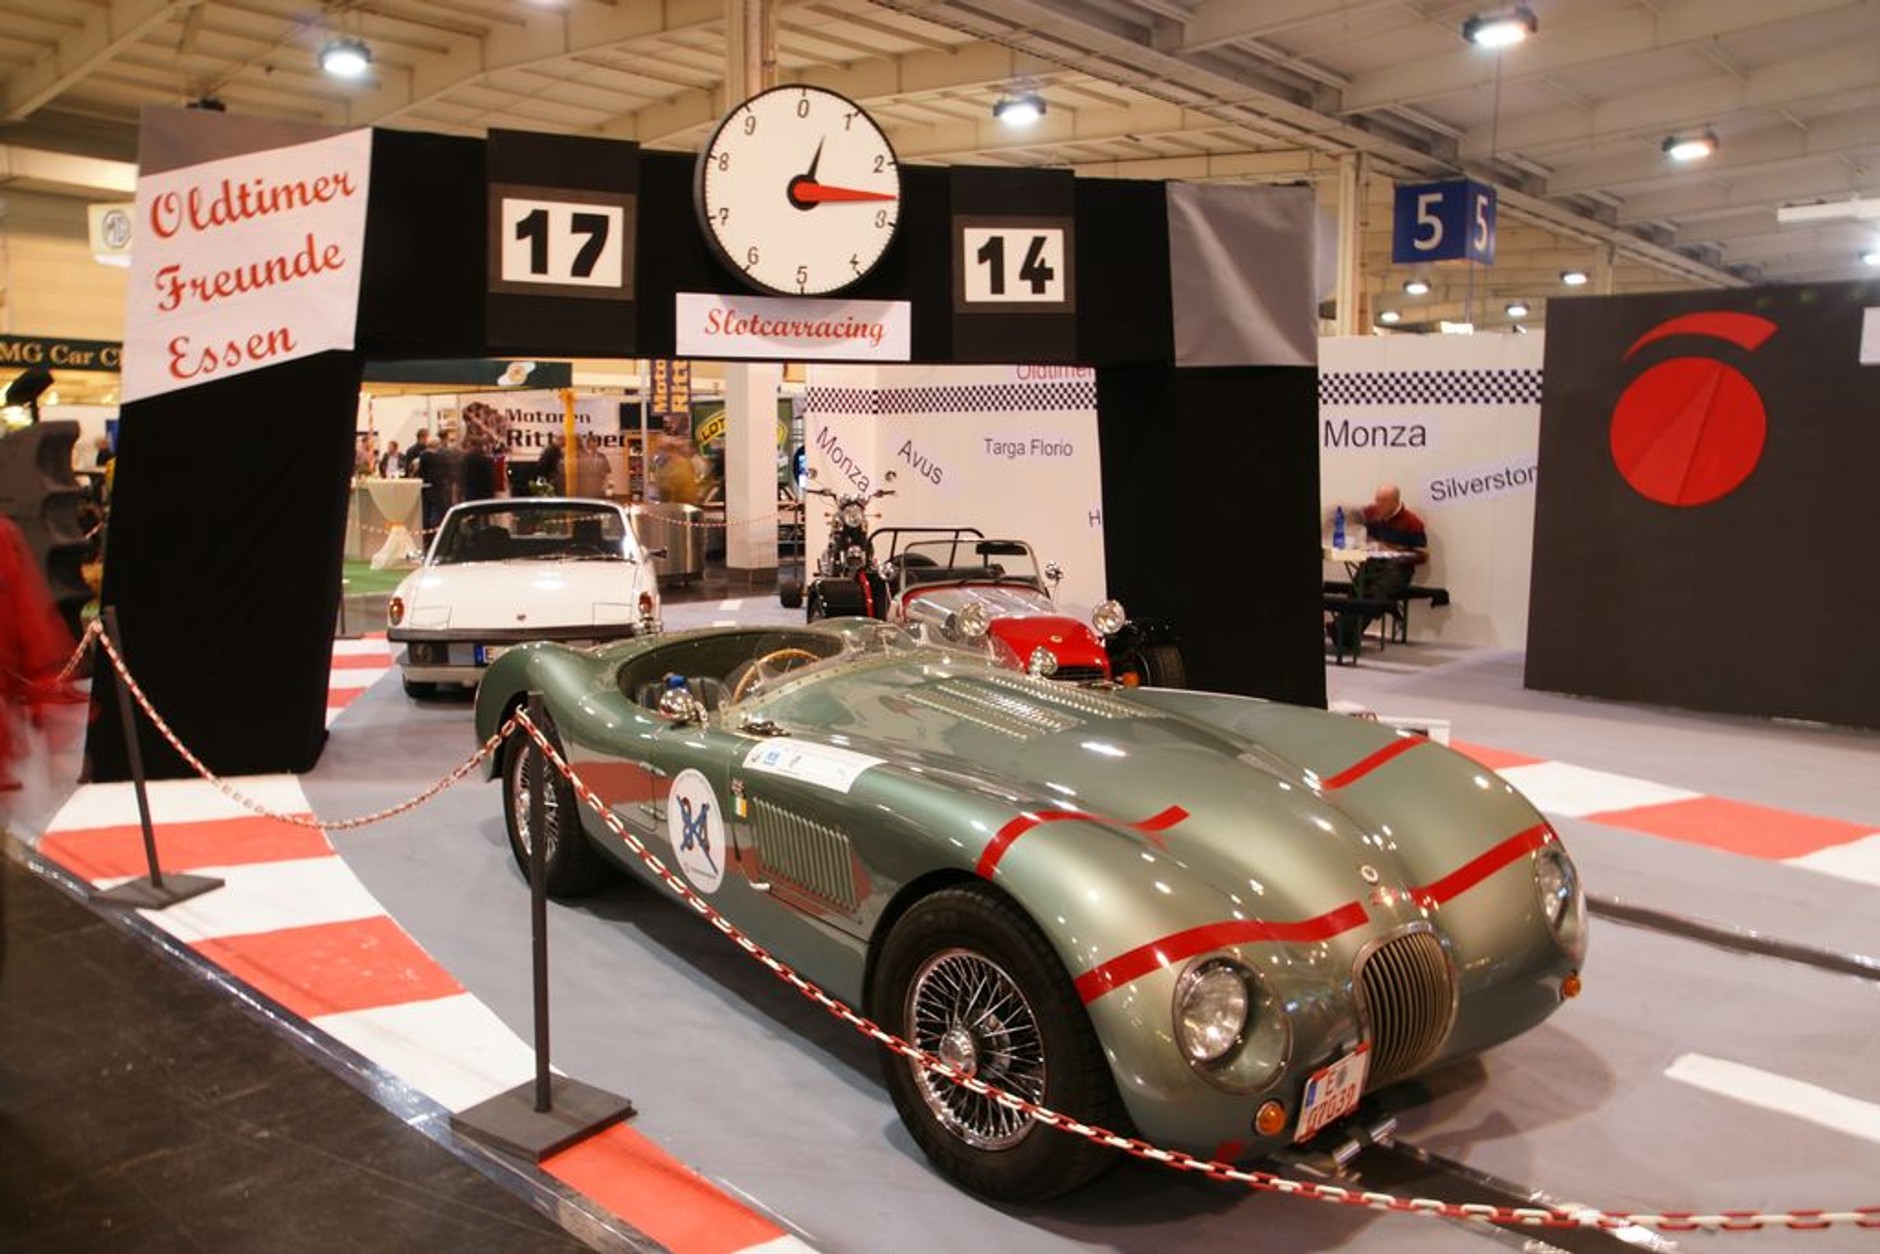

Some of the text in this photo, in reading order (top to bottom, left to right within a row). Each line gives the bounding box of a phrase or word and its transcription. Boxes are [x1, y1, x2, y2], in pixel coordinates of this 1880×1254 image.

[744, 115, 756, 136] 9
[843, 113, 853, 131] 1
[718, 152, 729, 171] 8
[873, 155, 885, 173] 2
[150, 171, 356, 239] Oldtimer
[874, 210, 886, 229] 3
[1414, 193, 1443, 251] 5
[1474, 194, 1489, 252] 5
[515, 209, 610, 278] 17
[748, 246, 759, 265] 6
[154, 232, 346, 312] Freunde
[796, 266, 808, 285] 5
[849, 253, 859, 272] 4
[977, 236, 1054, 295] 14
[705, 308, 884, 348] Slotcarracing
[0, 343, 43, 364] MG
[50, 344, 95, 365] Car
[168, 326, 296, 379] Essen
[1323, 418, 1427, 448] Monza
[816, 426, 870, 493] Monza
[898, 440, 944, 485] Avus
[984, 438, 1074, 459] Targa Florio
